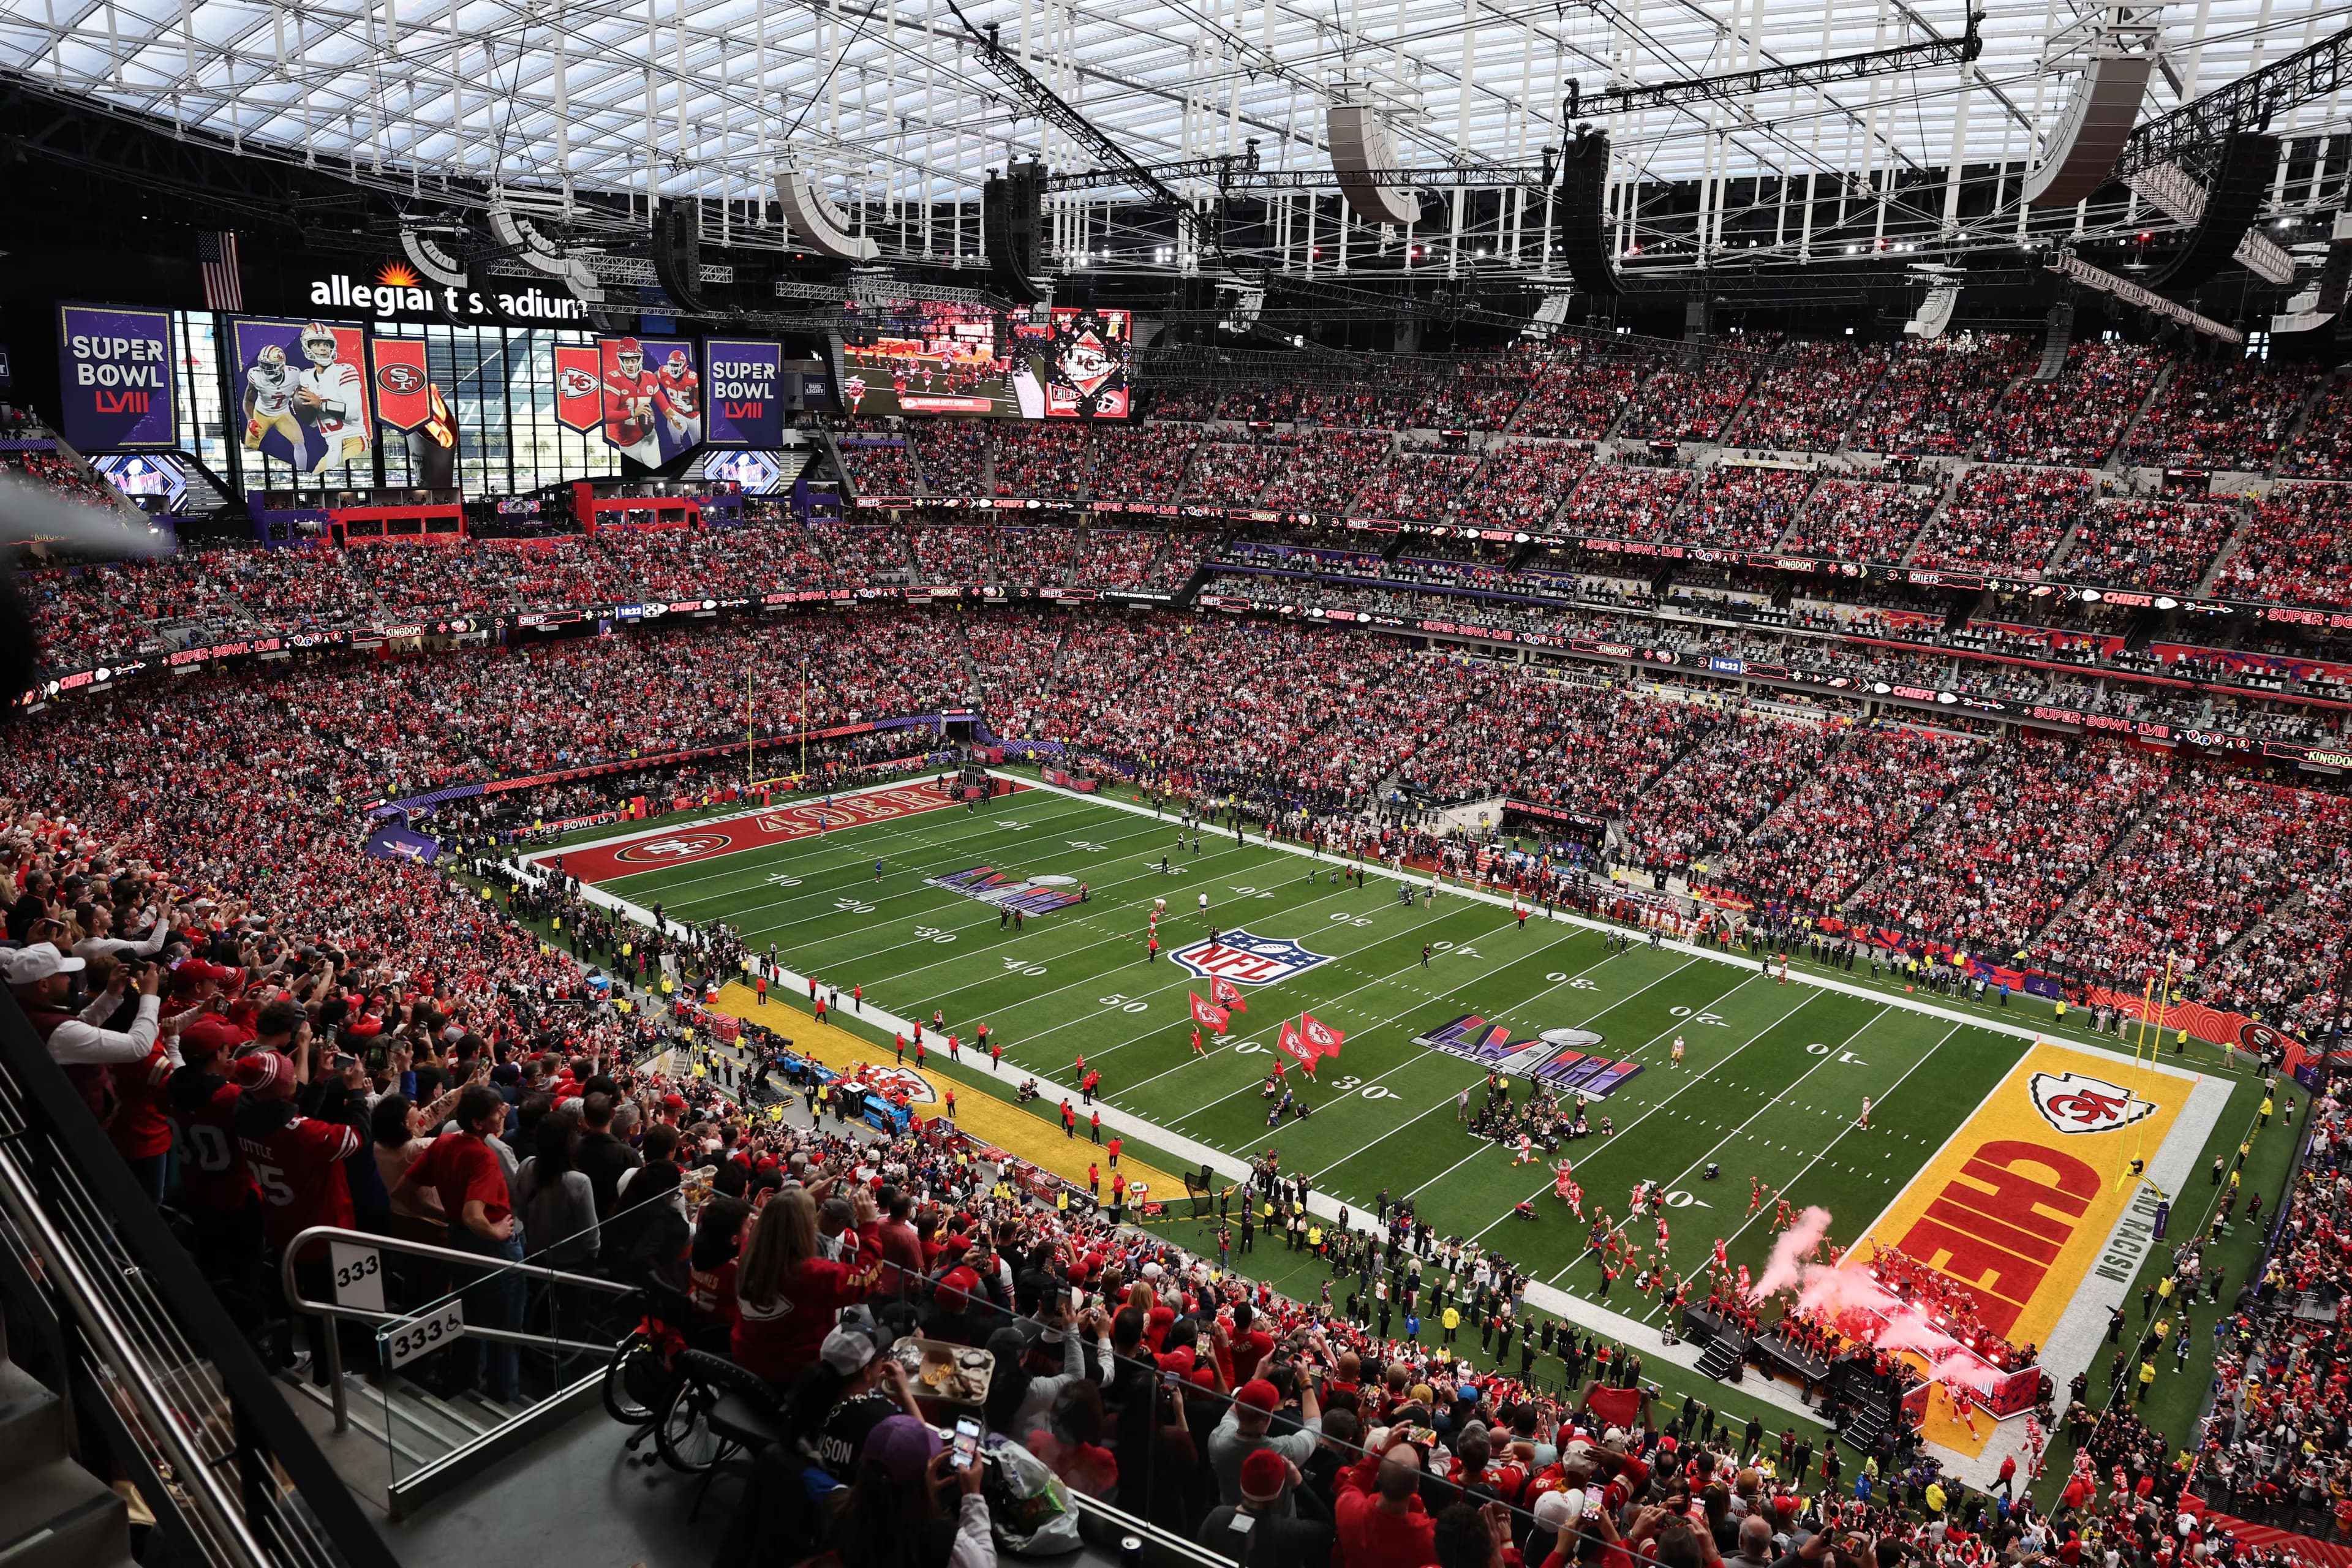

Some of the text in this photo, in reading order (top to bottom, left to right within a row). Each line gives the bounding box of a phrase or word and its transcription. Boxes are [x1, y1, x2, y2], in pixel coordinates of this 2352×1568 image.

[469, 287, 589, 320] sadium
[72, 335, 164, 361] SUPER
[77, 363, 164, 387] BOWL
[712, 361, 775, 380] SUPER
[390, 368, 418, 391] SF
[568, 374, 592, 391] KC
[714, 382, 774, 399] BOWL
[95, 391, 149, 413] LVIII
[271, 395, 285, 410] 7
[725, 402, 763, 418] LVIII
[993, 499, 1025, 508] CHIEFS
[1093, 502, 1122, 511] SUPER
[1128, 503, 1157, 513] BOWL
[1251, 512, 1276, 521] KINGDOM
[1348, 519, 1368, 528] CHIEFS
[1480, 530, 1513, 541] CHIEFS
[1586, 539, 1683, 558] SUPER BOWL LVIII
[1777, 559, 1811, 571] KINGDOM
[1911, 573, 1939, 584] CHIEFS
[767, 589, 850, 604] SUPER BOWL LVIII
[931, 587, 959, 596] KINGDOM
[1041, 589, 1063, 597] CHIEFS
[2103, 592, 2153, 607] CHIEFS
[669, 601, 702, 612] CHIEFS
[1202, 597, 1221, 605] CHIEFS
[519, 614, 545, 624] CHIEFS
[1325, 609, 1356, 621] CHIEFS
[2267, 608, 2352, 628] SUPER BO
[386, 625, 421, 637] KINGDOM
[1423, 620, 1513, 641] SUPER BOWL LVIII
[170, 638, 279, 665] SUPER BOWL LVIII
[1599, 644, 1629, 656] KINGDOM
[1715, 661, 1738, 671] 18:22
[59, 671, 93, 690] CHIEFS
[1893, 685, 1936, 701] CHIEFS
[2033, 706, 2169, 738] SUPER BOWL LVIII
[2308, 751, 2352, 767] KINGDO
[705, 809, 765, 824] TAKES
[772, 801, 806, 810] ALL
[525, 824, 558, 838] SPER
[563, 818, 594, 831] BOWL
[641, 834, 710, 856] SF
[767, 872, 802, 887] 10
[932, 882, 980, 899] SUPER
[834, 897, 876, 914] 20
[1329, 913, 1373, 927] 50
[914, 926, 957, 943] 30
[1433, 941, 1477, 957] 40
[1005, 959, 1047, 976] 40
[1182, 944, 1281, 980] NFL
[1545, 972, 1595, 990] 30
[1098, 994, 1148, 1013] 50
[1669, 1006, 1724, 1025] 20
[1428, 1043, 1505, 1070] SUPER
[1806, 1043, 1860, 1063] 10
[1331, 1075, 1389, 1099] 30
[1880, 1140, 2101, 1340] CHIE
[2095, 1218, 2154, 1283] RACISM
[337, 1254, 379, 1288] 333
[394, 1319, 443, 1359] 333
